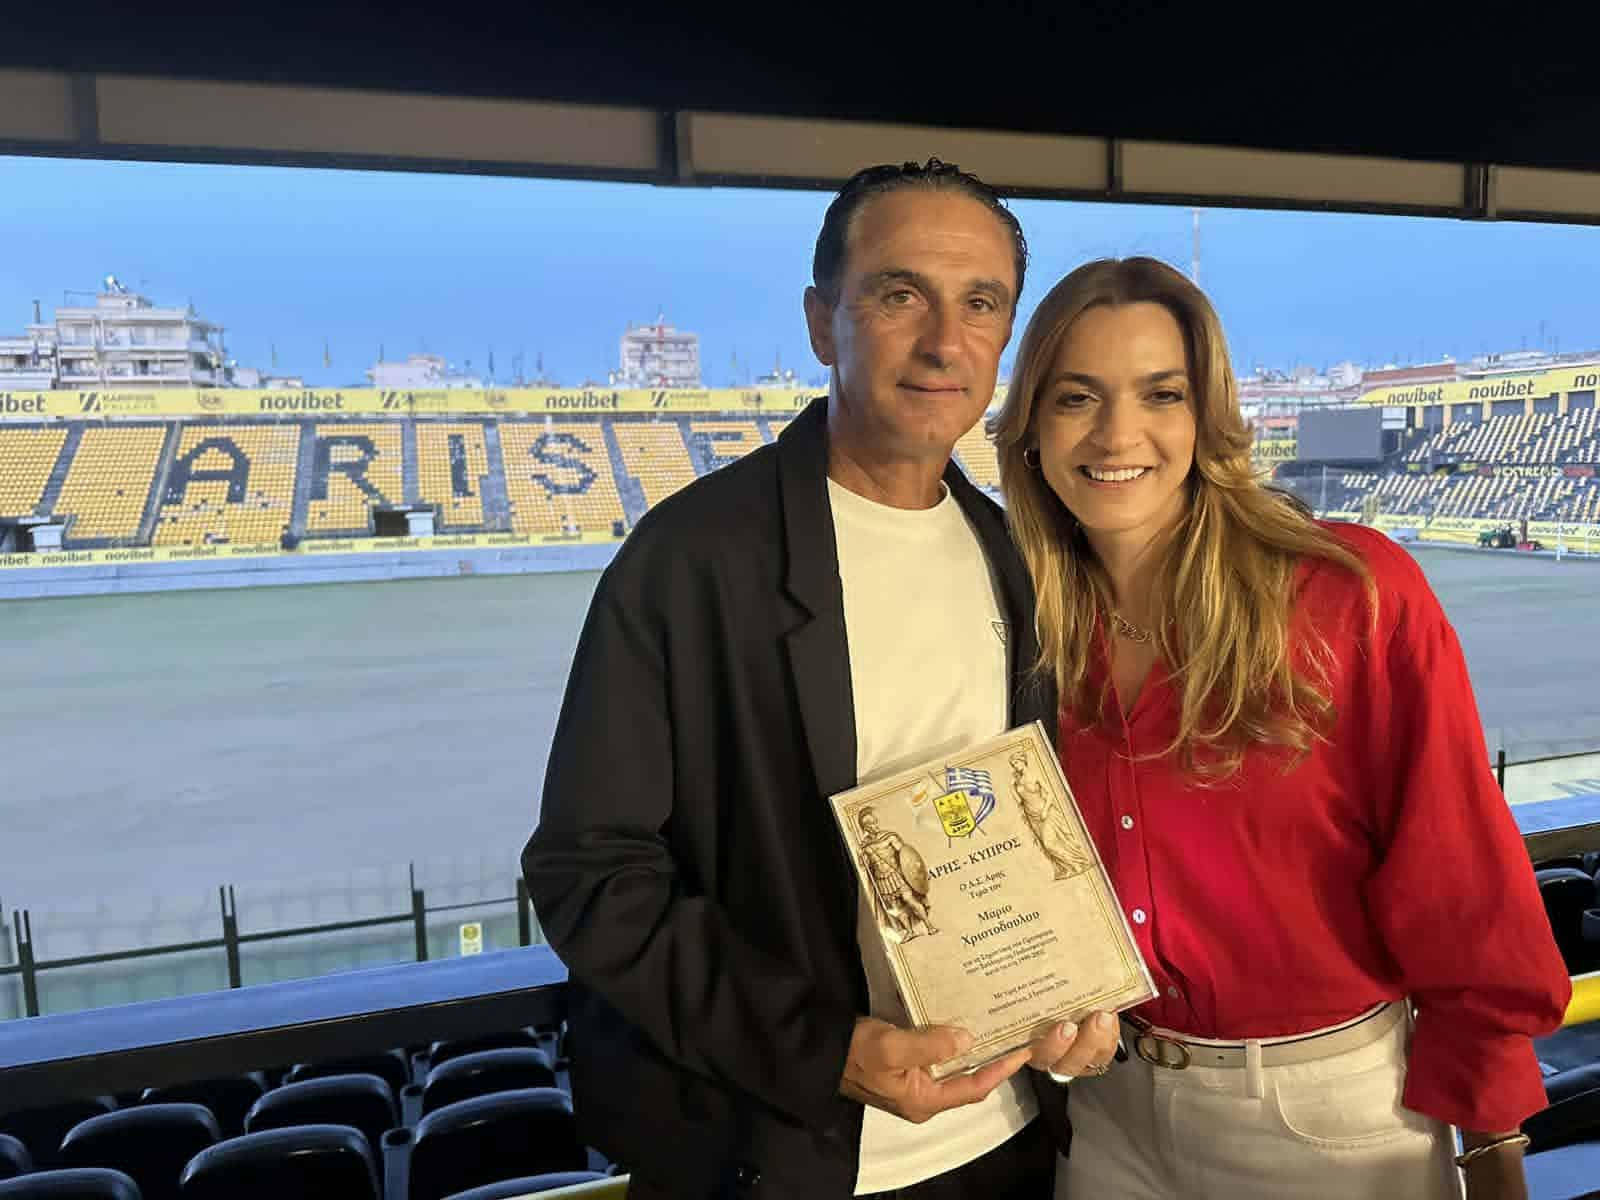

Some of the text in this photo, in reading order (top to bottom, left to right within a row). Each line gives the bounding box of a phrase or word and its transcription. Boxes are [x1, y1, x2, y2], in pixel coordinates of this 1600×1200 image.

[1387, 387, 1443, 405] novibet
[1468, 379, 1535, 399] novibet
[259, 390, 344, 410] novibet
[545, 391, 618, 409] novibet
[42, 551, 93, 565] novibet
[104, 549, 154, 562] novibet
[968, 838, 1022, 865] ΚΥΠΡΟΣ
